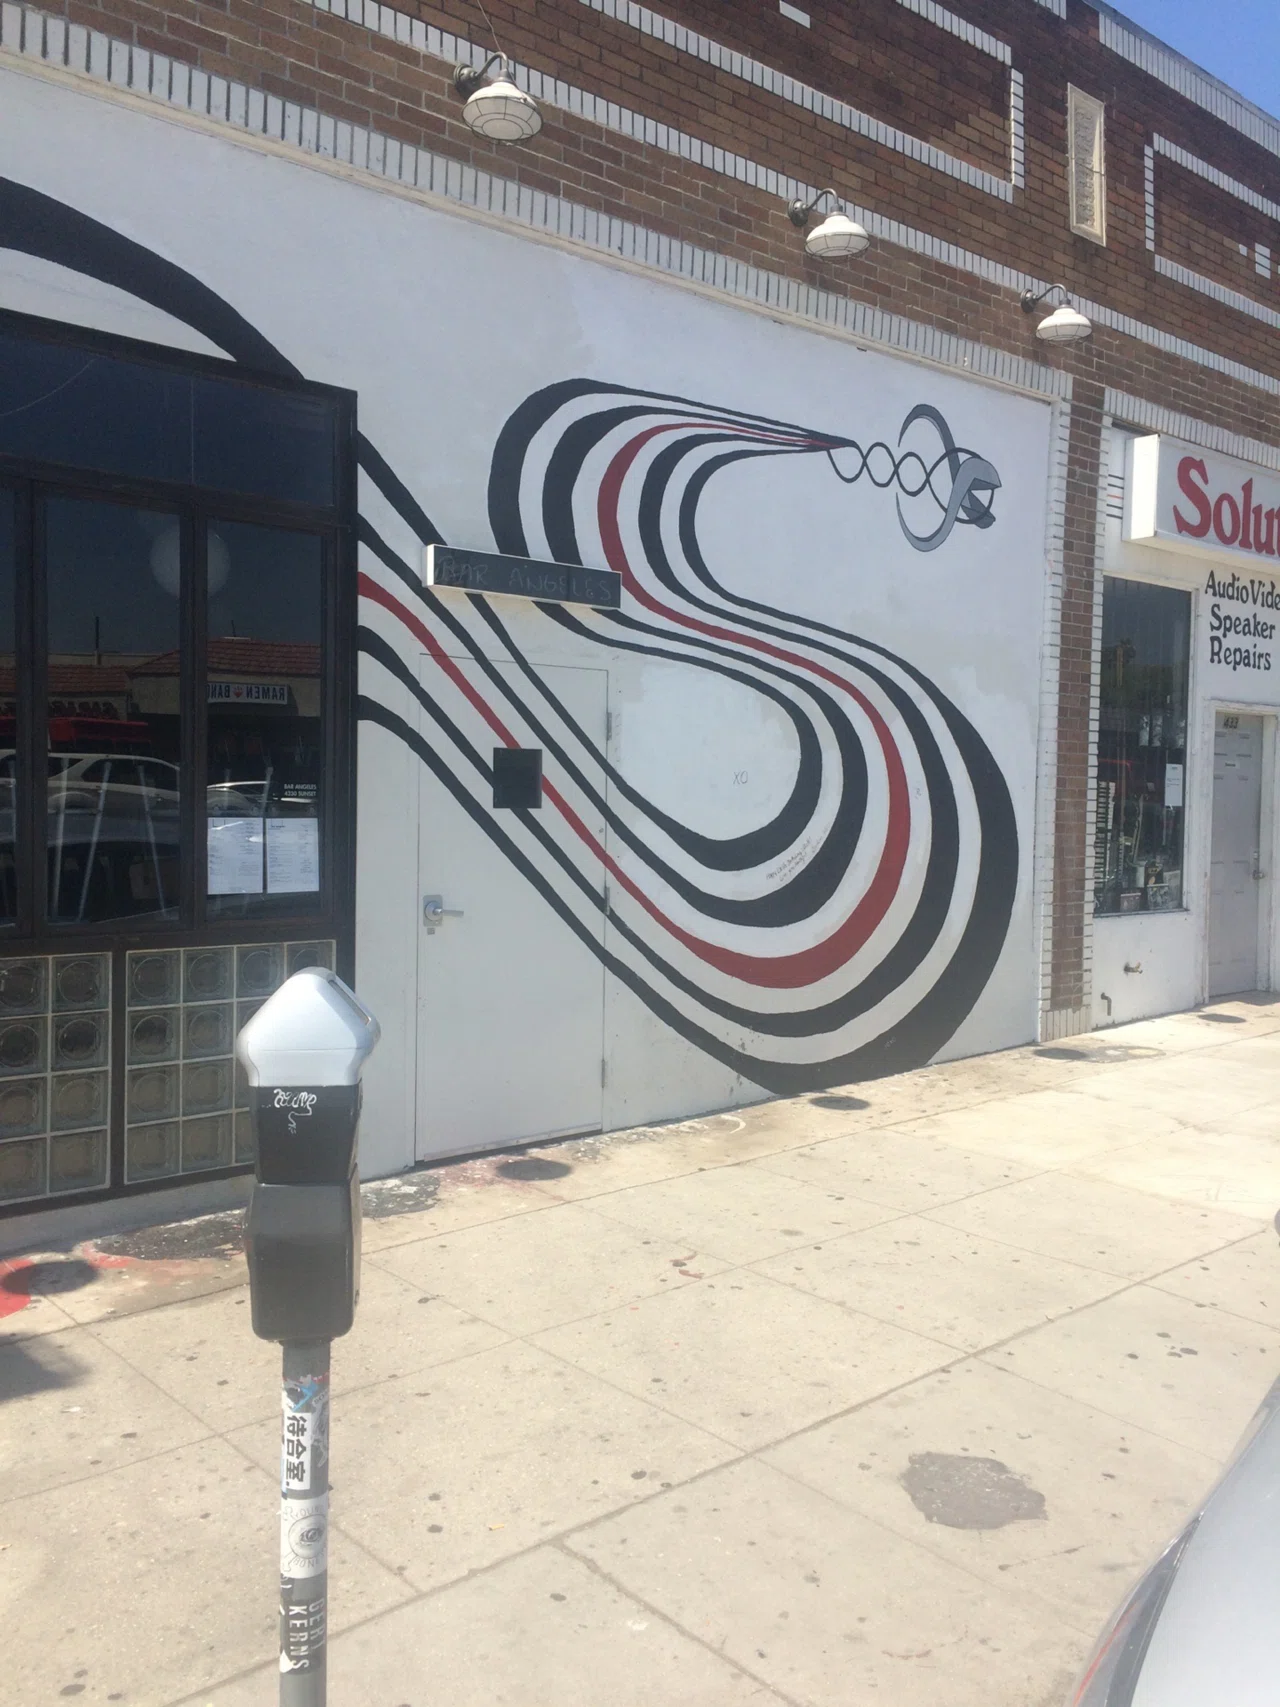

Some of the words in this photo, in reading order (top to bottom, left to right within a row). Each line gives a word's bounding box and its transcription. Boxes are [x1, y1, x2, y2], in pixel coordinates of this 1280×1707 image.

[1209, 603, 1276, 639] Speaker
[1209, 635, 1271, 672] Repairs
[732, 770, 749, 785] XO
[288, 1605, 310, 1670] KERNS
